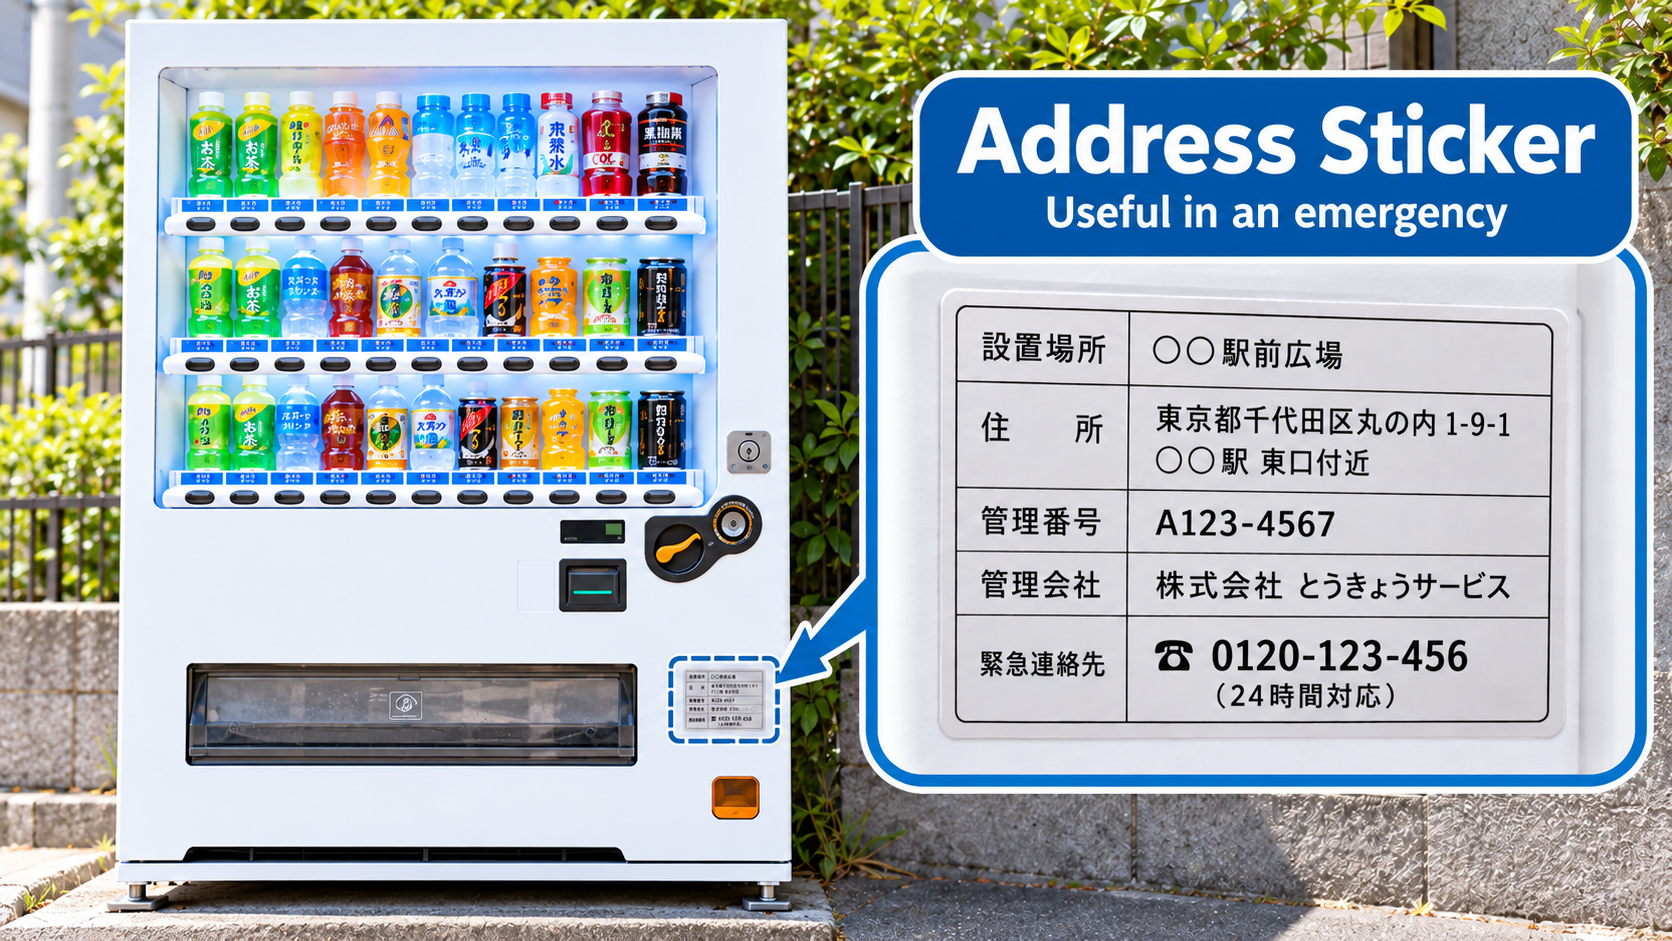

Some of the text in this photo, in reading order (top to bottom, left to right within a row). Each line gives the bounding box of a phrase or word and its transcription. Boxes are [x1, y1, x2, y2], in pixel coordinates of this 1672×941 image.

[982, 331, 1106, 365] 設置場所
[1156, 403, 1510, 437] 東京都千代田区丸の内 1-9-1
[1260, 447, 1370, 477] 東口付近
[981, 505, 1102, 537] 管理番号
[1155, 509, 1335, 538] A123-4567
[981, 568, 1101, 600] 管理会社
[1155, 569, 1511, 600] 株式会社 とうきょうサービス
[980, 650, 1106, 678] 緊急連絡先
[1211, 638, 1468, 672] 0120-123-456
[1216, 682, 1395, 710] （24時間対応）
